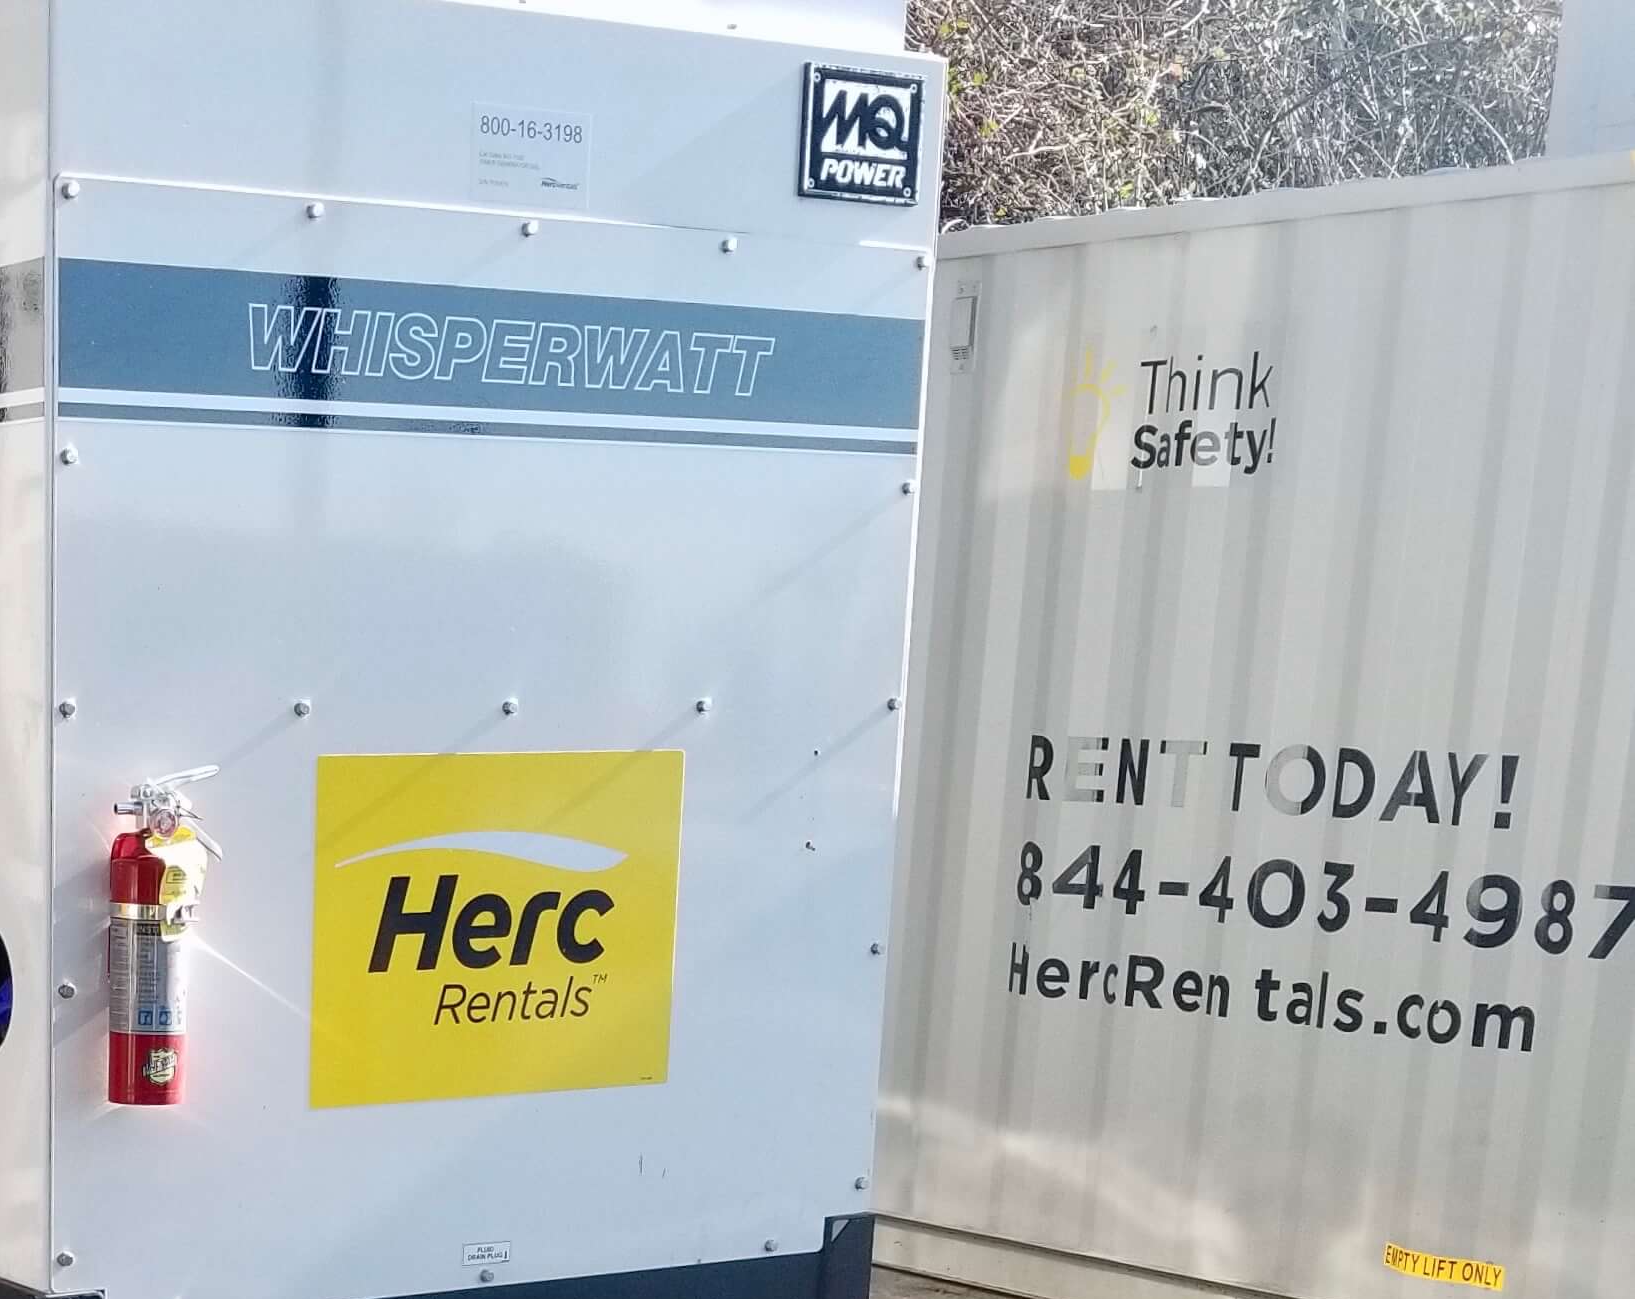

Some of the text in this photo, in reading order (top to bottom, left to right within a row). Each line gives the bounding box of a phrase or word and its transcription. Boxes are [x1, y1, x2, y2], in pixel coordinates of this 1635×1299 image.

[479, 114, 583, 144] 800-16-3198
[821, 88, 909, 153] MQ
[819, 157, 907, 188] POWER
[248, 302, 776, 398] WHISPERWATT
[1140, 350, 1274, 415] Think
[1131, 417, 1277, 475] Safety!
[1026, 734, 1520, 830] RENT TODAY!
[368, 874, 615, 973] Herc
[1016, 840, 1635, 961] 844-403-4987
[1385, 1244, 1502, 1287] EMPTY LIFT ONLY
